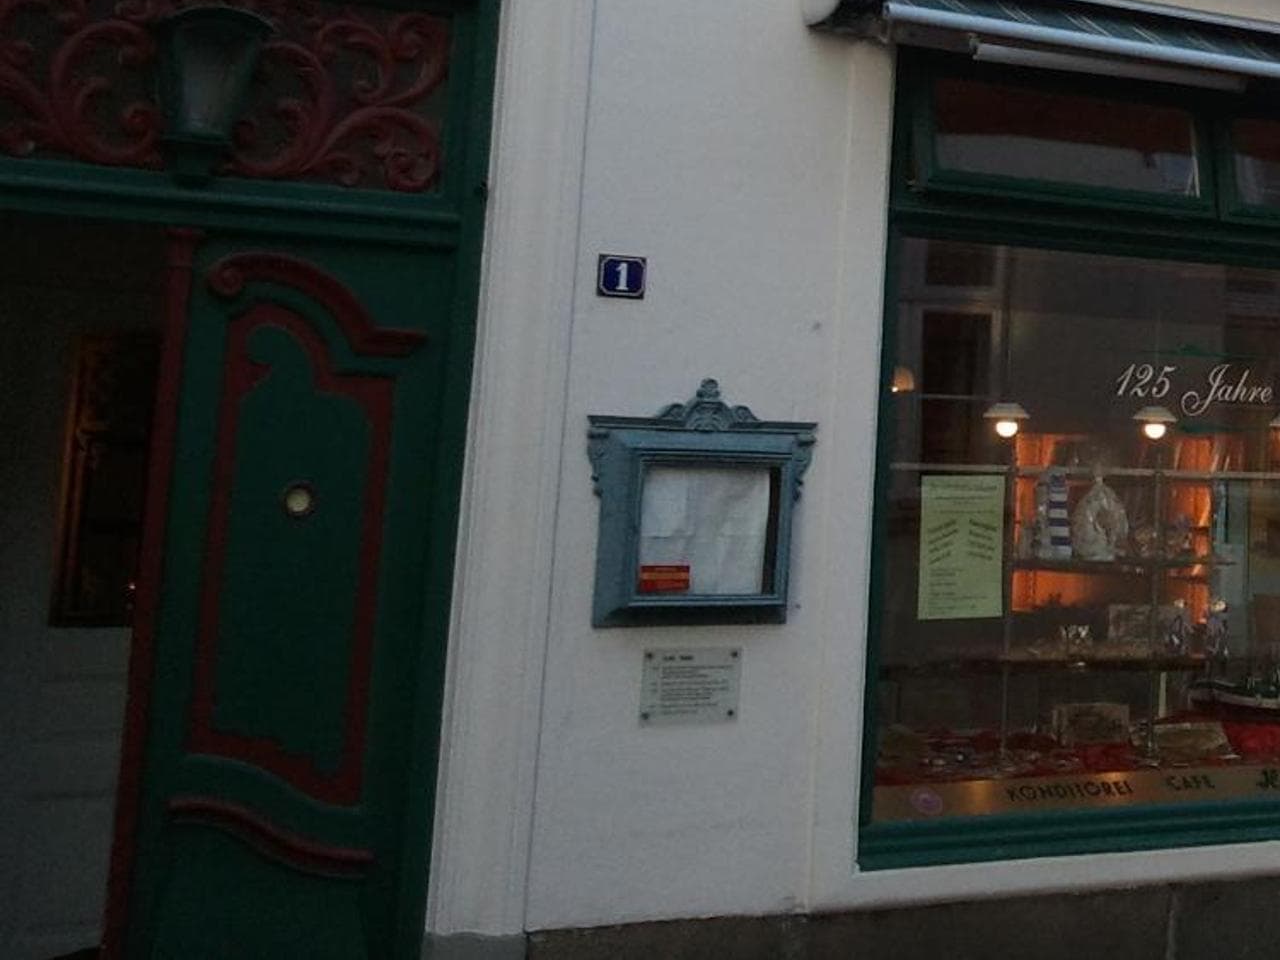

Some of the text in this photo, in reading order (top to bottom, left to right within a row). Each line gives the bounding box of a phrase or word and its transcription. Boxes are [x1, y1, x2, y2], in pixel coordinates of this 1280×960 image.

[615, 262, 629, 290] 1
[1116, 363, 1274, 417] 125 Jahre
